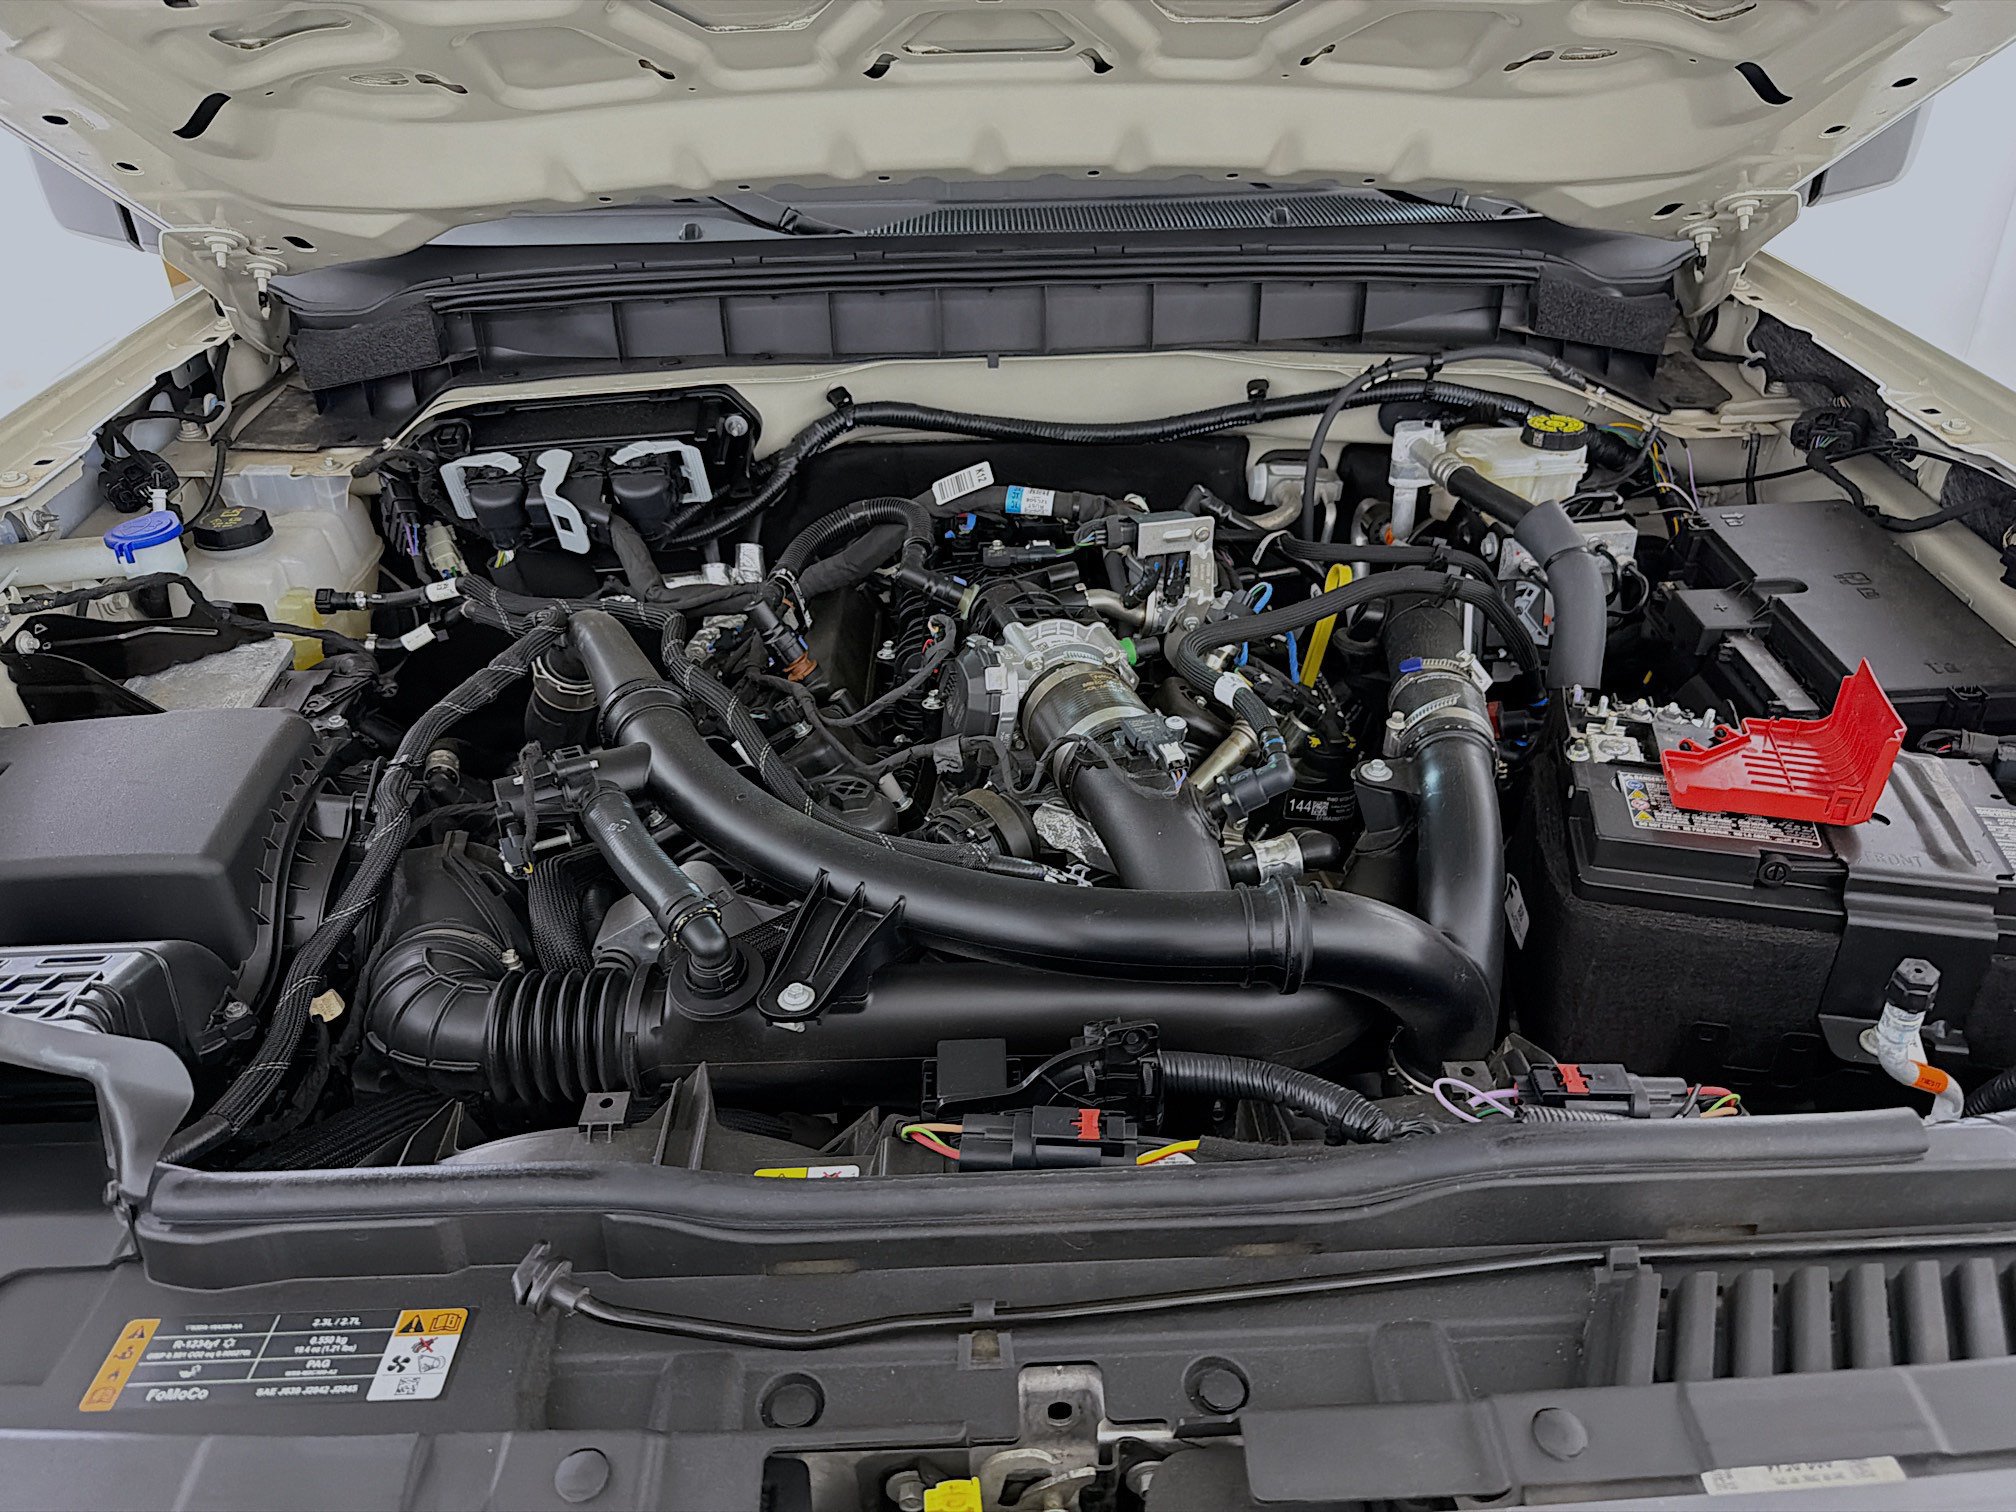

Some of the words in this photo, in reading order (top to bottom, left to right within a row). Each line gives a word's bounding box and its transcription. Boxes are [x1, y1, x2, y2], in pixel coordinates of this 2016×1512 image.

[975, 467, 987, 482] K12
[1289, 798, 1312, 812] 144
[1864, 851, 1922, 868] FRONT
[305, 1359, 331, 1369] PAG
[146, 1387, 209, 1401] FoMoCo
[255, 1387, 278, 1397] SAE
